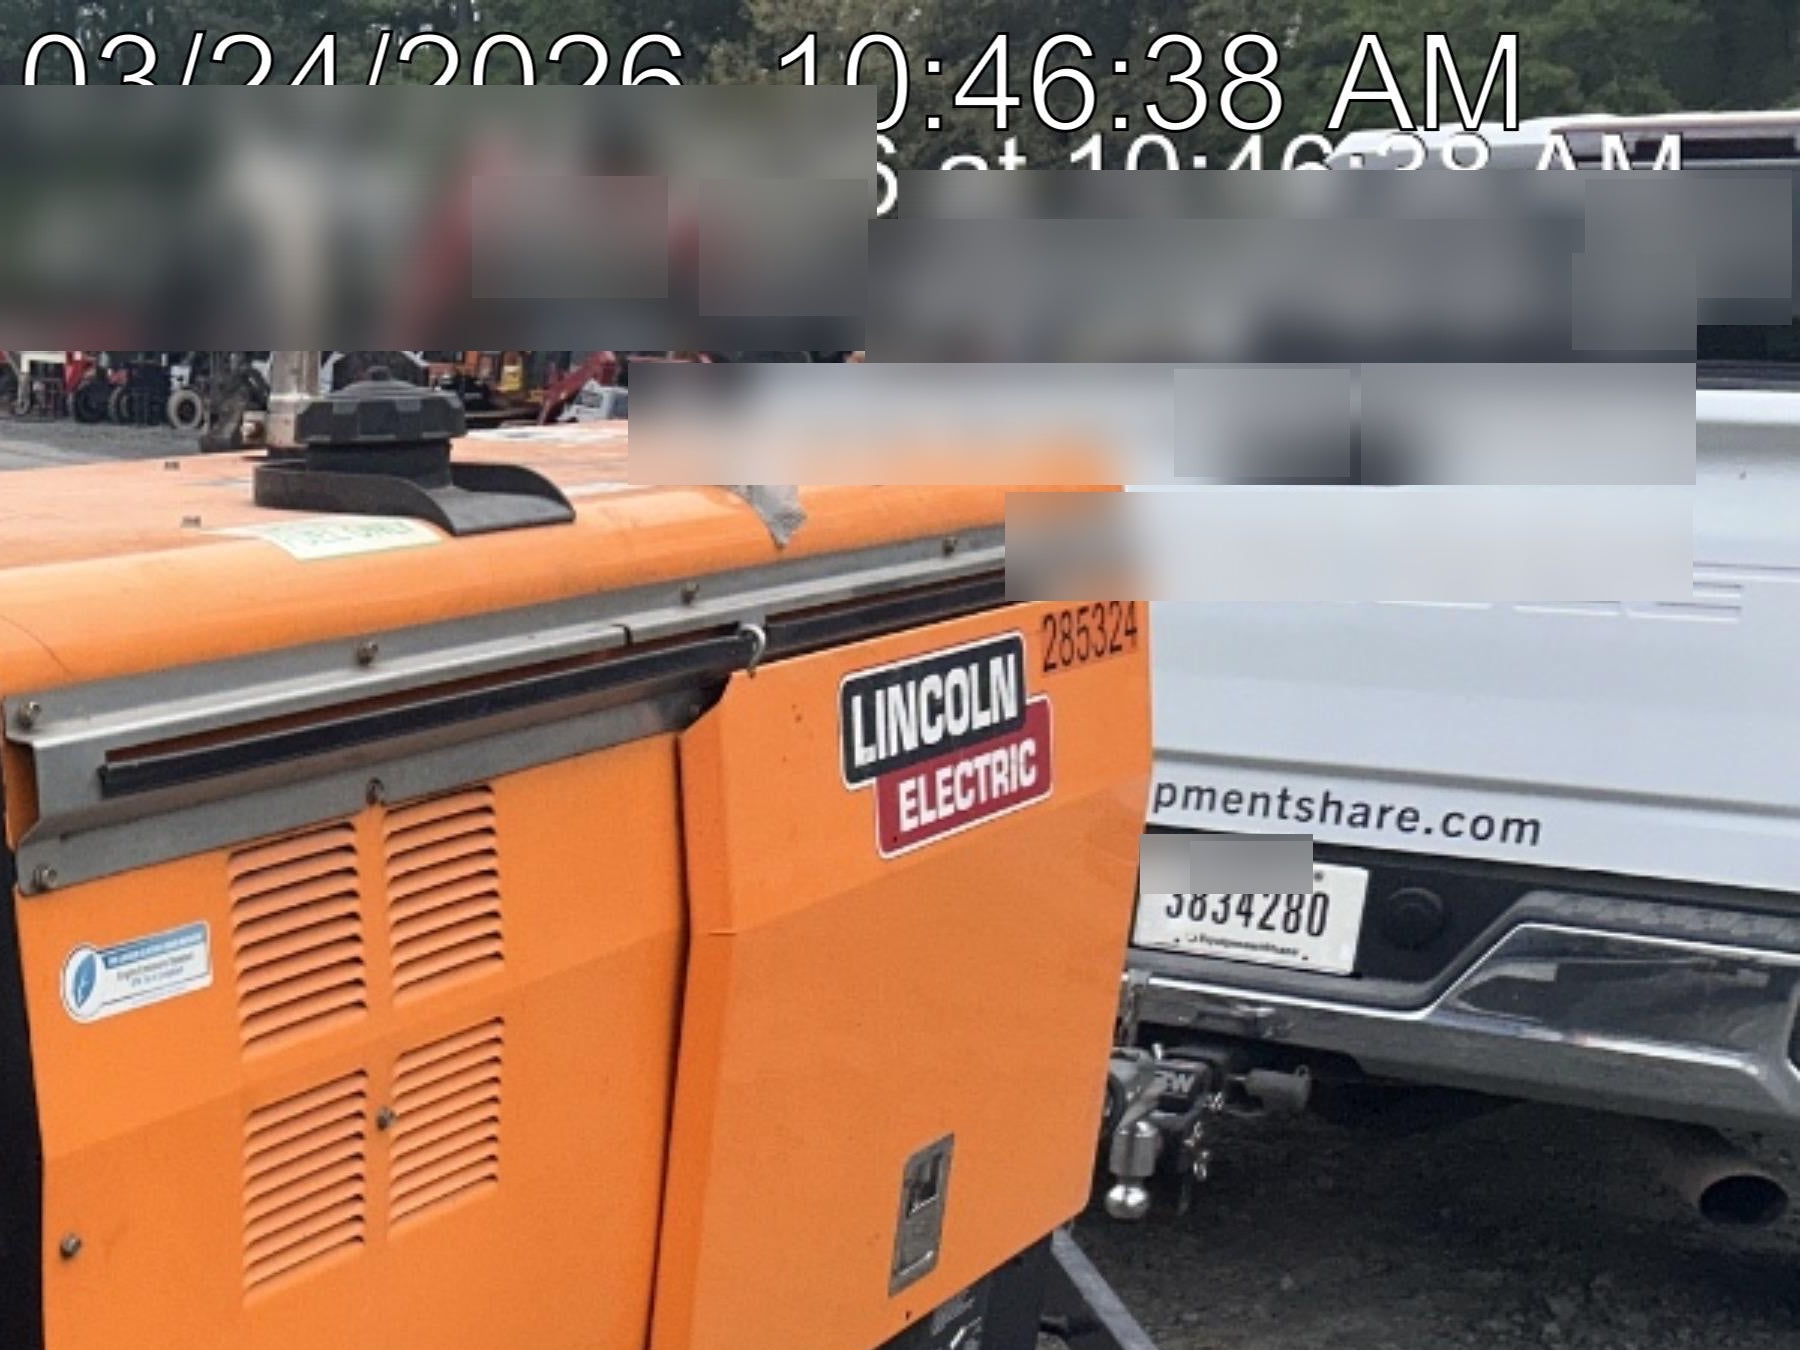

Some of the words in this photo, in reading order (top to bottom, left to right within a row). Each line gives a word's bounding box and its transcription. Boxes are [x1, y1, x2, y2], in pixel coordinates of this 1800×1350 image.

[1042, 600, 1138, 673] 285324
[851, 653, 1018, 768] LINCOLN
[899, 738, 1037, 833] ELECTRIC
